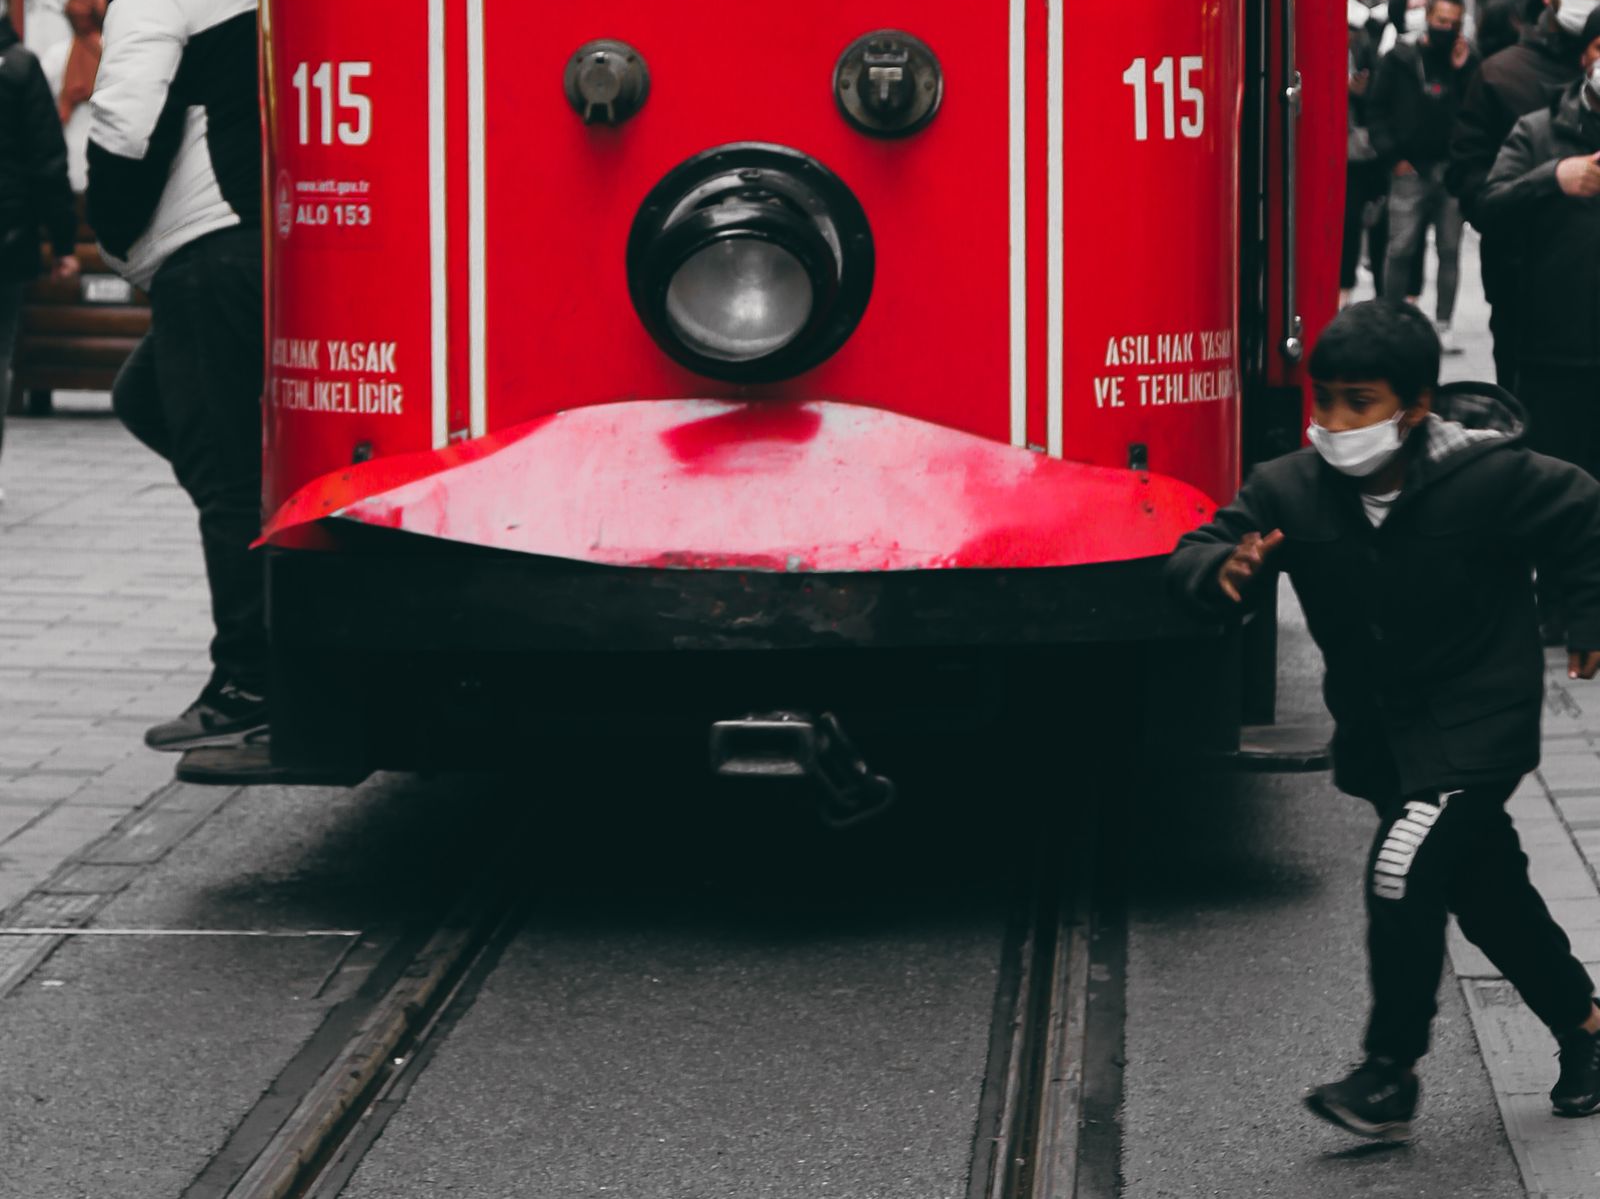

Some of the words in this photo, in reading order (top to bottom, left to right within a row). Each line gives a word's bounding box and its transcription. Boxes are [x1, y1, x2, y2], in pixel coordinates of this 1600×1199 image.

[292, 61, 372, 146] 115
[1122, 55, 1205, 141] 115
[296, 203, 329, 226] ALO
[333, 203, 371, 227] 153
[327, 340, 398, 374] YASAK
[1104, 331, 1195, 368] ASILMAK
[1093, 375, 1125, 409] VE
[1373, 800, 1442, 901] PUMA
